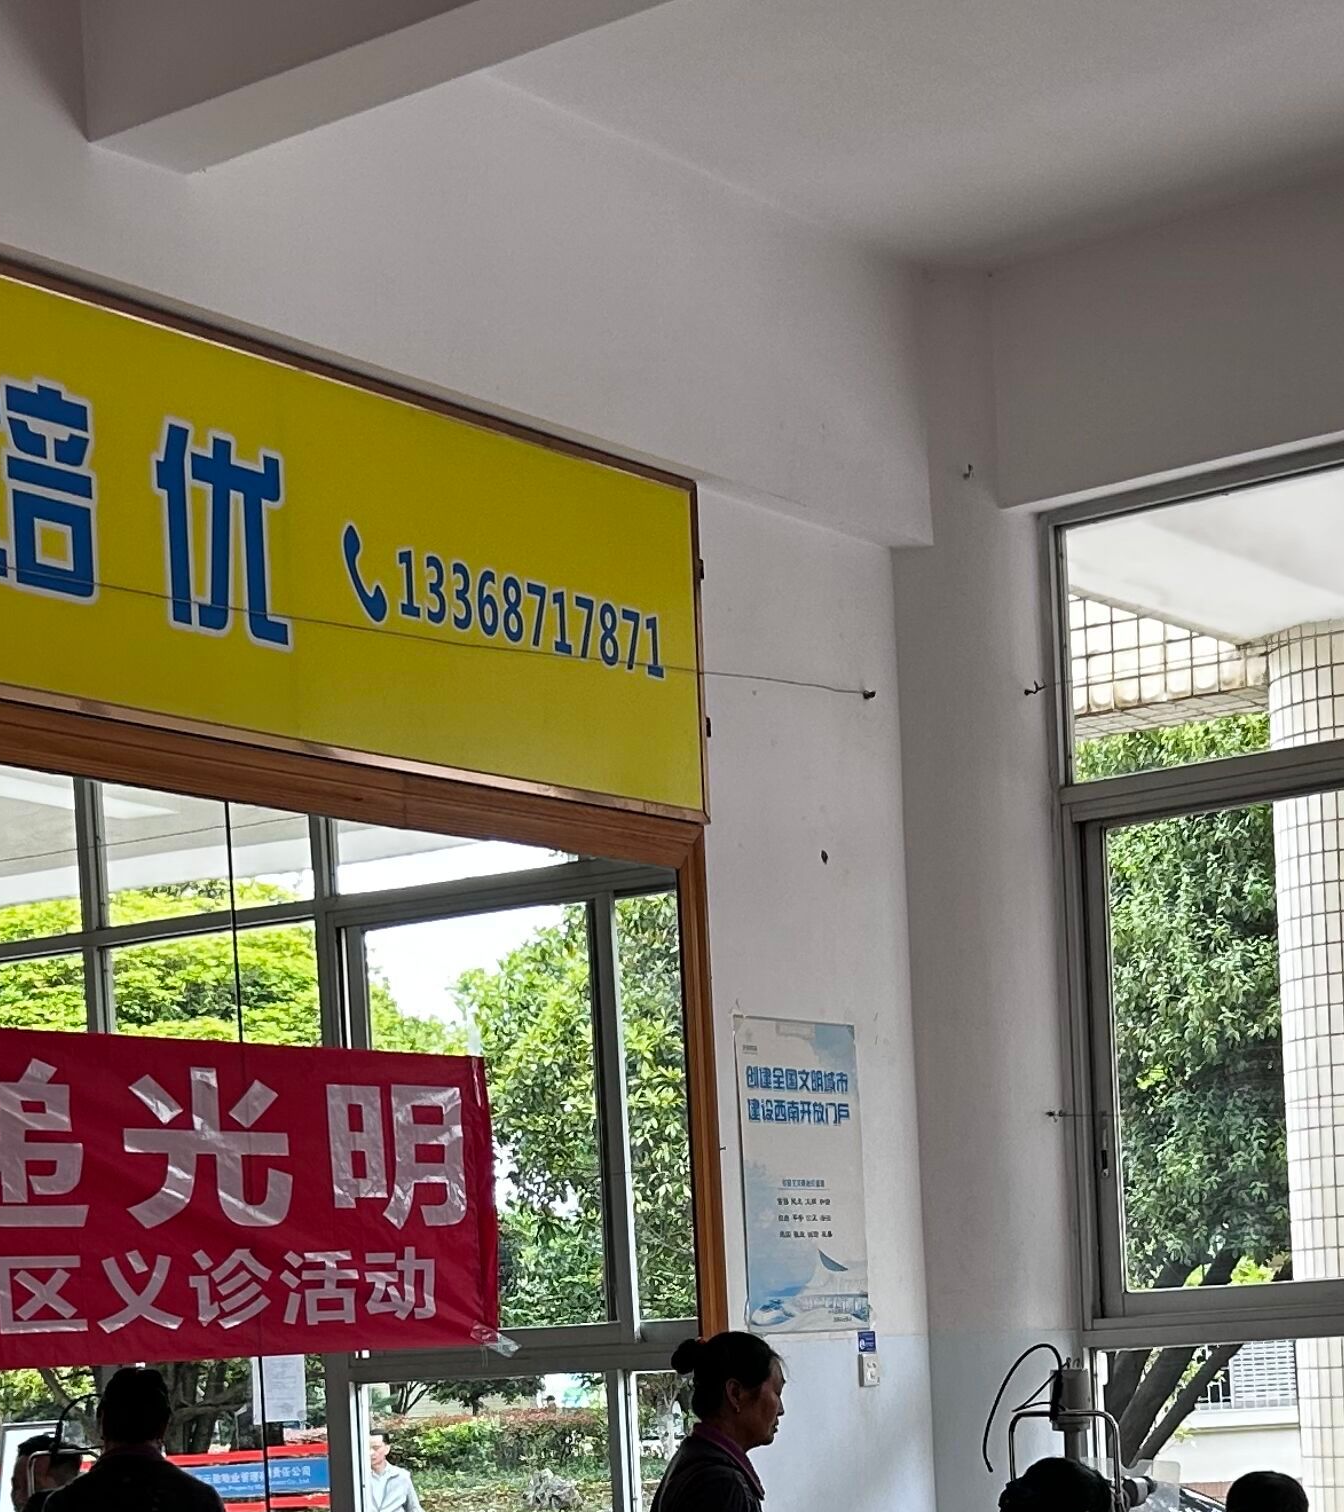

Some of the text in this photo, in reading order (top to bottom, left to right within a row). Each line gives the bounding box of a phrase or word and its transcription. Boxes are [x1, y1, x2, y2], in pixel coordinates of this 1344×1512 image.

[396, 546, 666, 681] 13368717871
[747, 1098, 851, 1126] 建设西南开放门户
